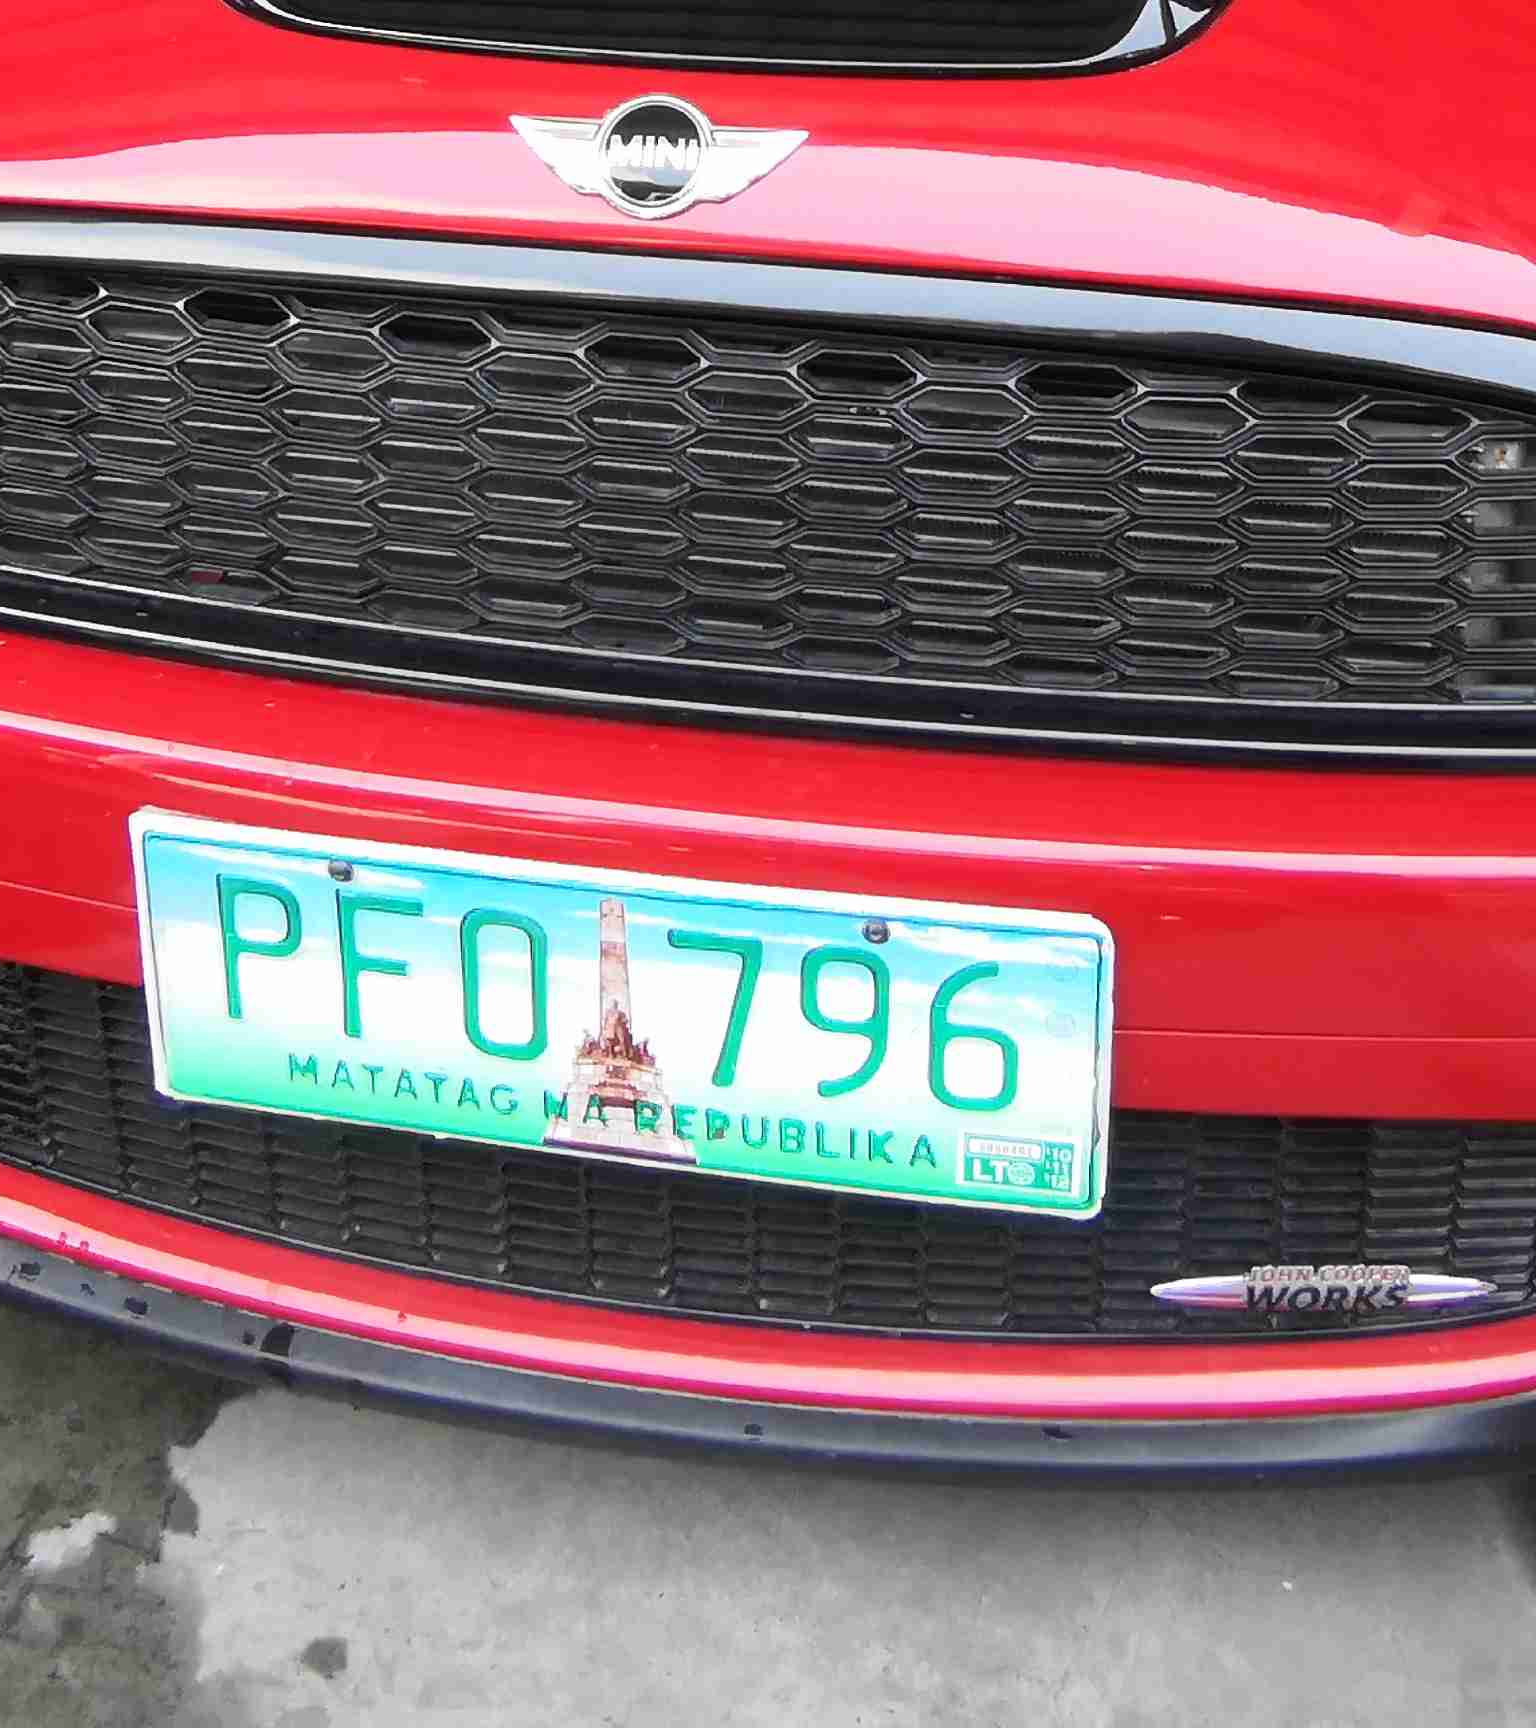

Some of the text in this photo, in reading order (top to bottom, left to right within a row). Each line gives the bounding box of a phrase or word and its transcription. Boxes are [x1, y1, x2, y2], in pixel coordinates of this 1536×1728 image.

[609, 133, 700, 171] MINI
[216, 874, 1019, 1112] PFO 796
[288, 1052, 937, 1168] MATATAG NA REPUBLIKA
[1250, 1264, 1314, 1281] JOHN
[1247, 1282, 1410, 1312] WORKS
